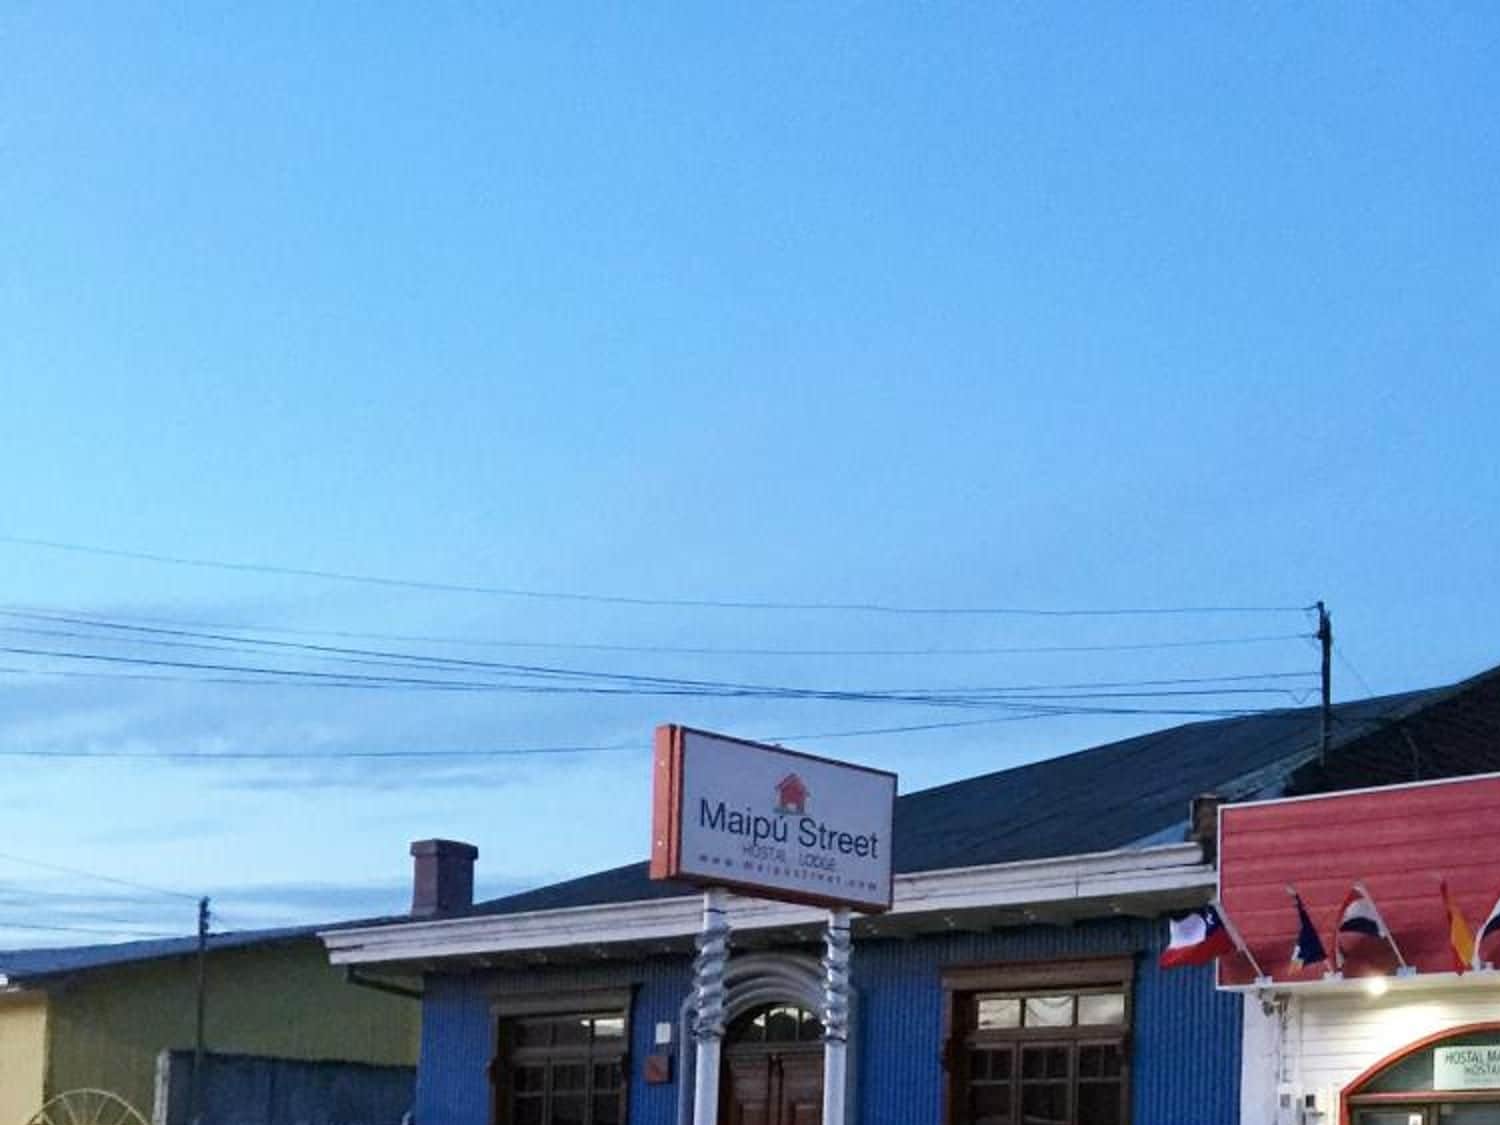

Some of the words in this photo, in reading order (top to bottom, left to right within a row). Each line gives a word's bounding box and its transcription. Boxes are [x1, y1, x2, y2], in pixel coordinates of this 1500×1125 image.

[700, 797, 788, 846] Maipú
[798, 817, 878, 859] Street
[743, 845, 786, 863] HOSTAL
[1444, 1050, 1482, 1064] HOSTAL
[1464, 1062, 1500, 1074] HOSTAL
